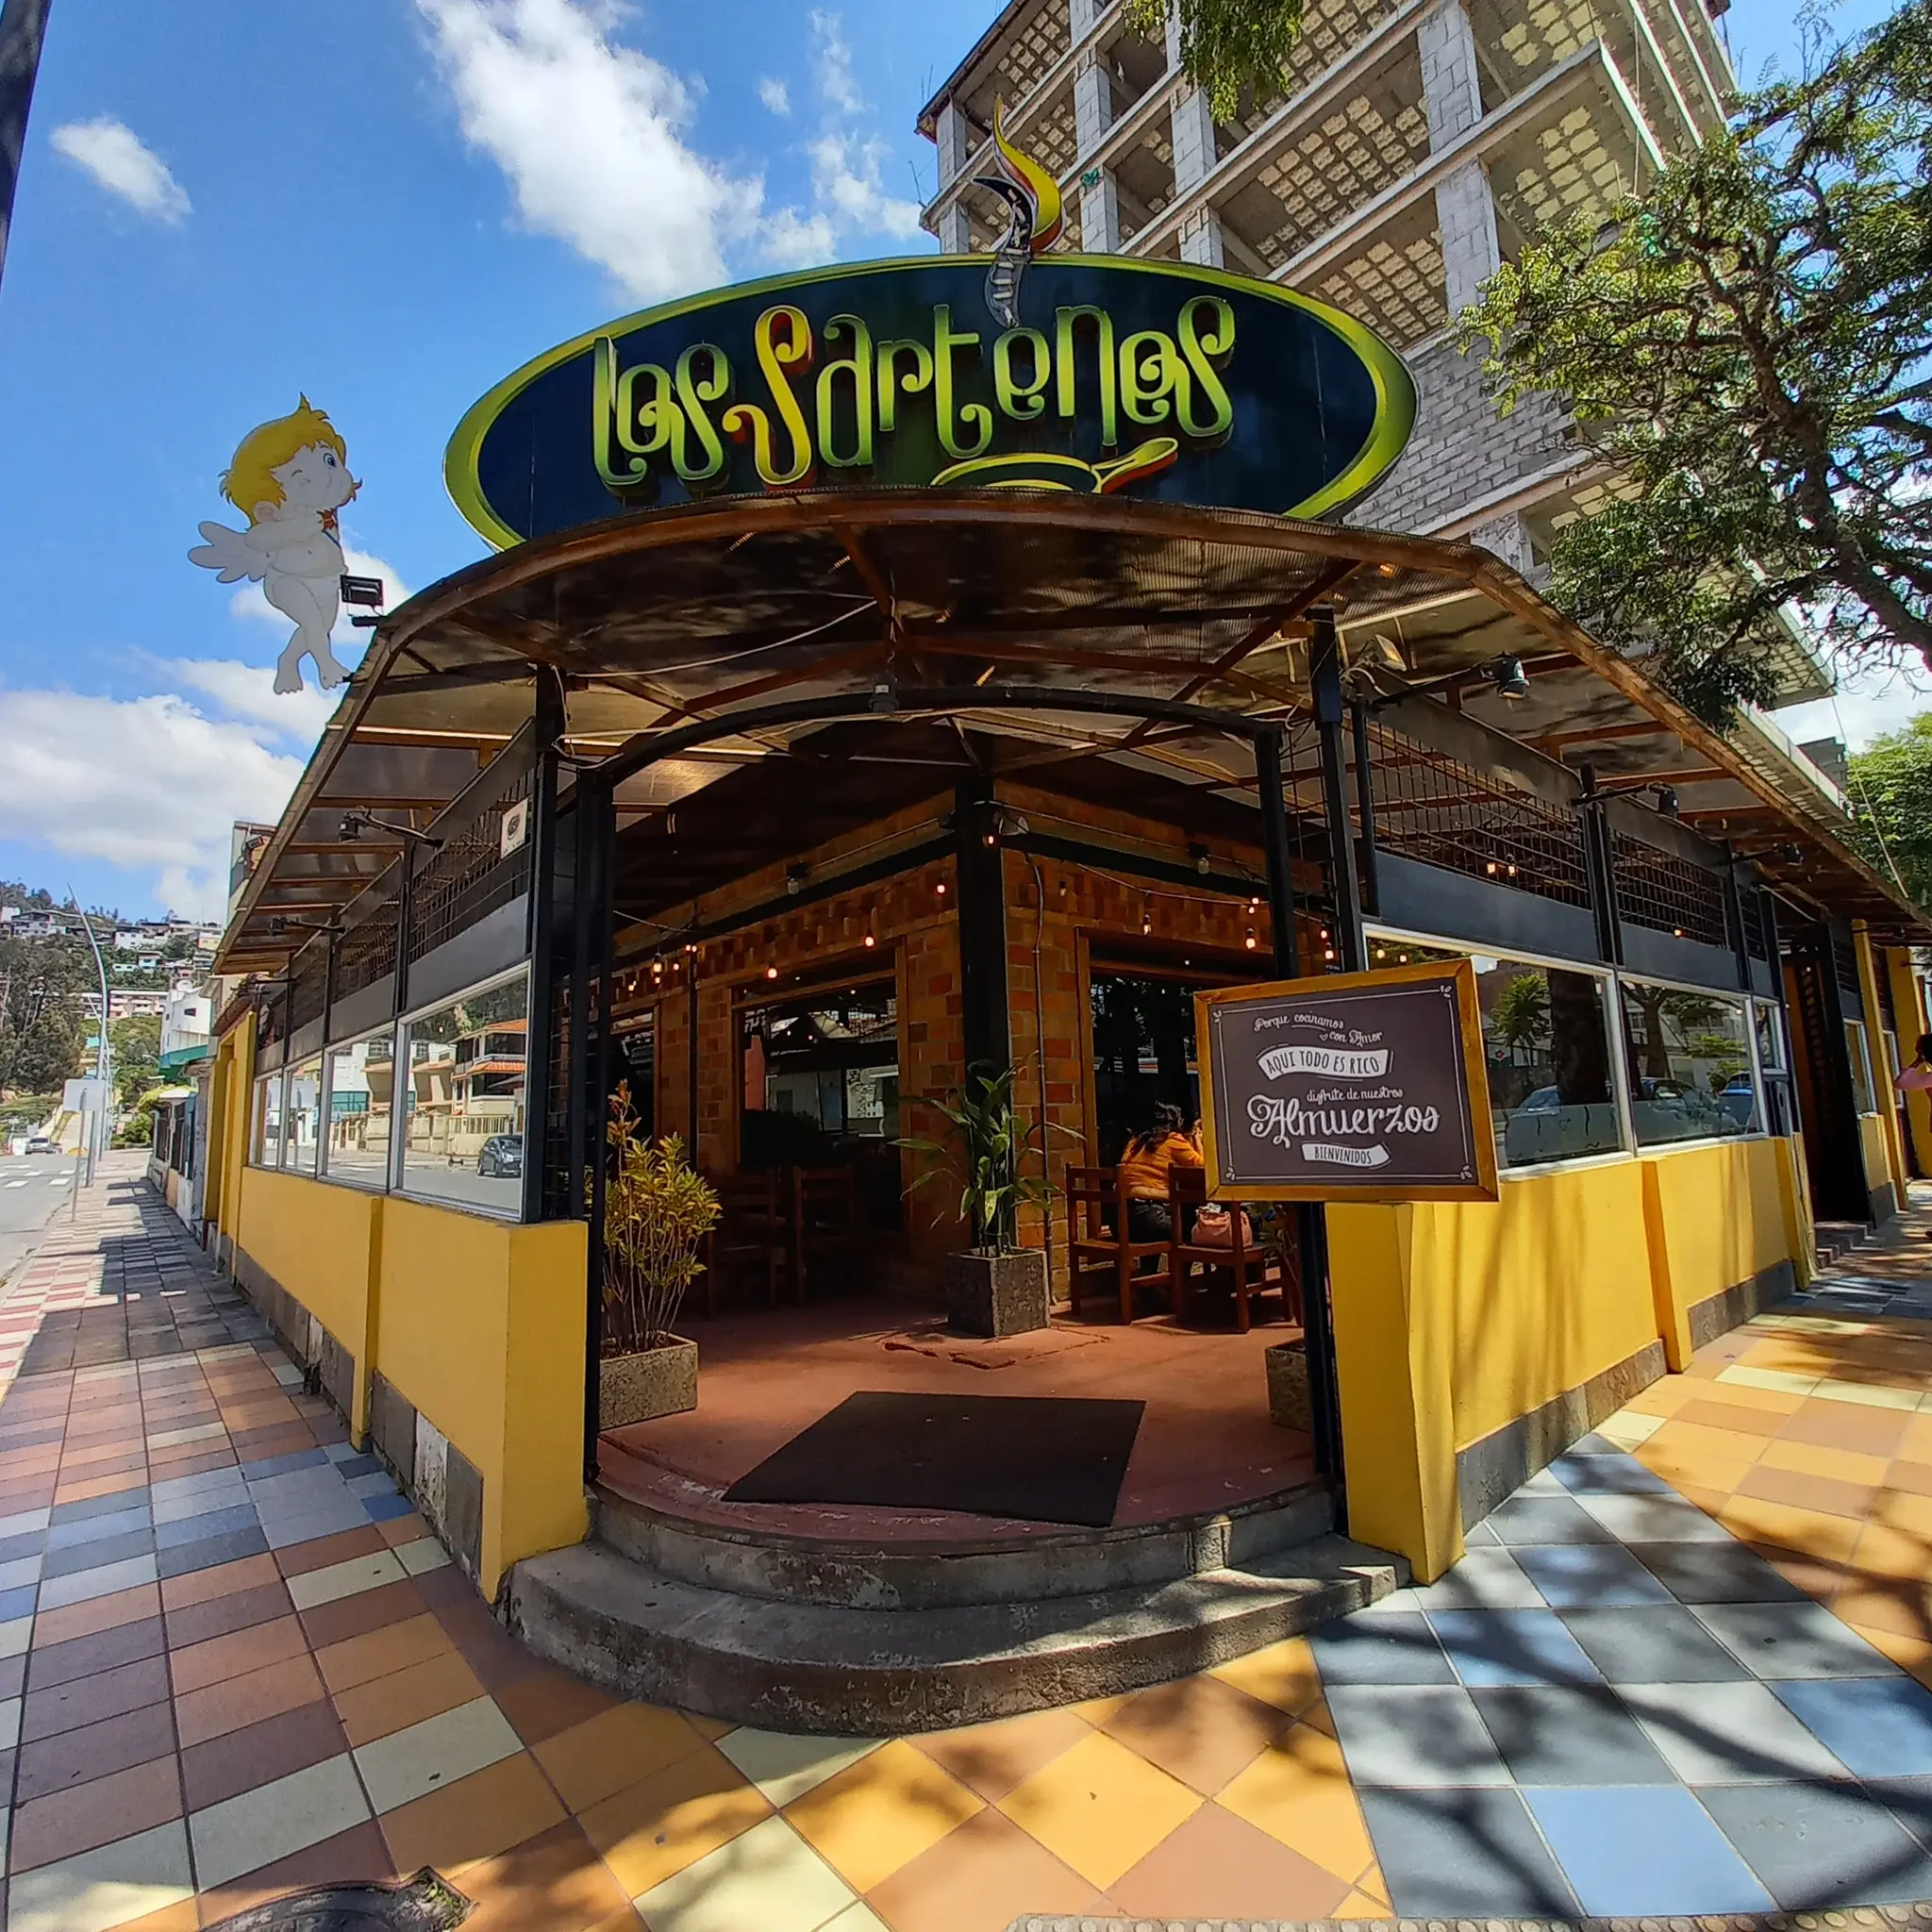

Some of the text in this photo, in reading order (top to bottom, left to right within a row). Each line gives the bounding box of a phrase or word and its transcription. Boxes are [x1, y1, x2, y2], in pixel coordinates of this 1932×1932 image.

[722, 294, 1236, 486] Sartenes
[1254, 1011, 1344, 1032] Porque cocinamos
[1328, 1029, 1383, 1047] con Amor
[1266, 1050, 1380, 1074] AQUI TODO ES RICO
[1307, 1085, 1404, 1105] disfrute de nuestros
[1246, 1093, 1441, 1149] Almuerzos
[1314, 1146, 1373, 1165] BIENVENIDOS
